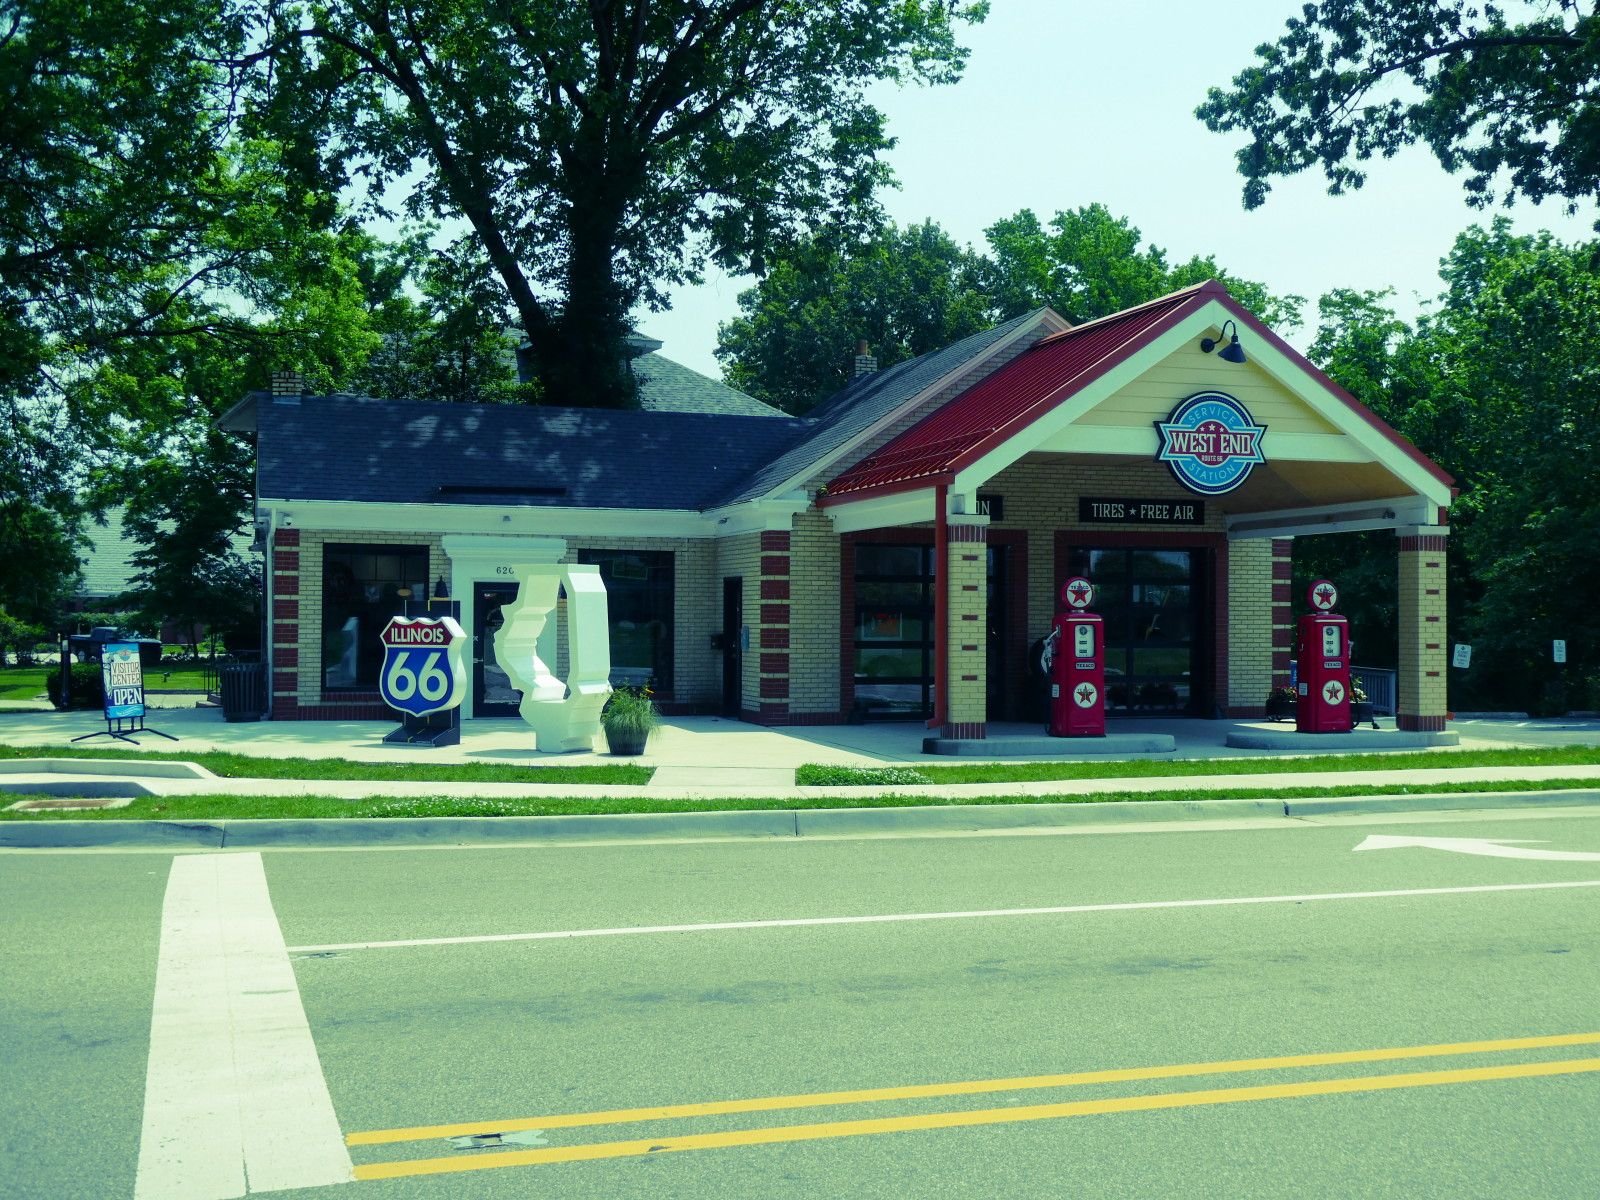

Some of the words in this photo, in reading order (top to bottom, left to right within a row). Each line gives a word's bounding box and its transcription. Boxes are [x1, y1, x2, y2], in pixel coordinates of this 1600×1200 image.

[1188, 406, 1236, 425] SERVICE
[1171, 432, 1217, 453] WEST
[1220, 433, 1251, 454] END
[1201, 454, 1216, 462] ROUTE
[1188, 463, 1236, 481] STATION
[1091, 503, 1125, 519] TIRES
[1140, 503, 1169, 519] FREE
[1173, 505, 1195, 520] AIR
[391, 627, 444, 643] ILLINOIS
[112, 662, 140, 673] VISITOR
[112, 673, 141, 685] CENTER
[387, 651, 448, 702] 66
[114, 688, 143, 705] OPEN
